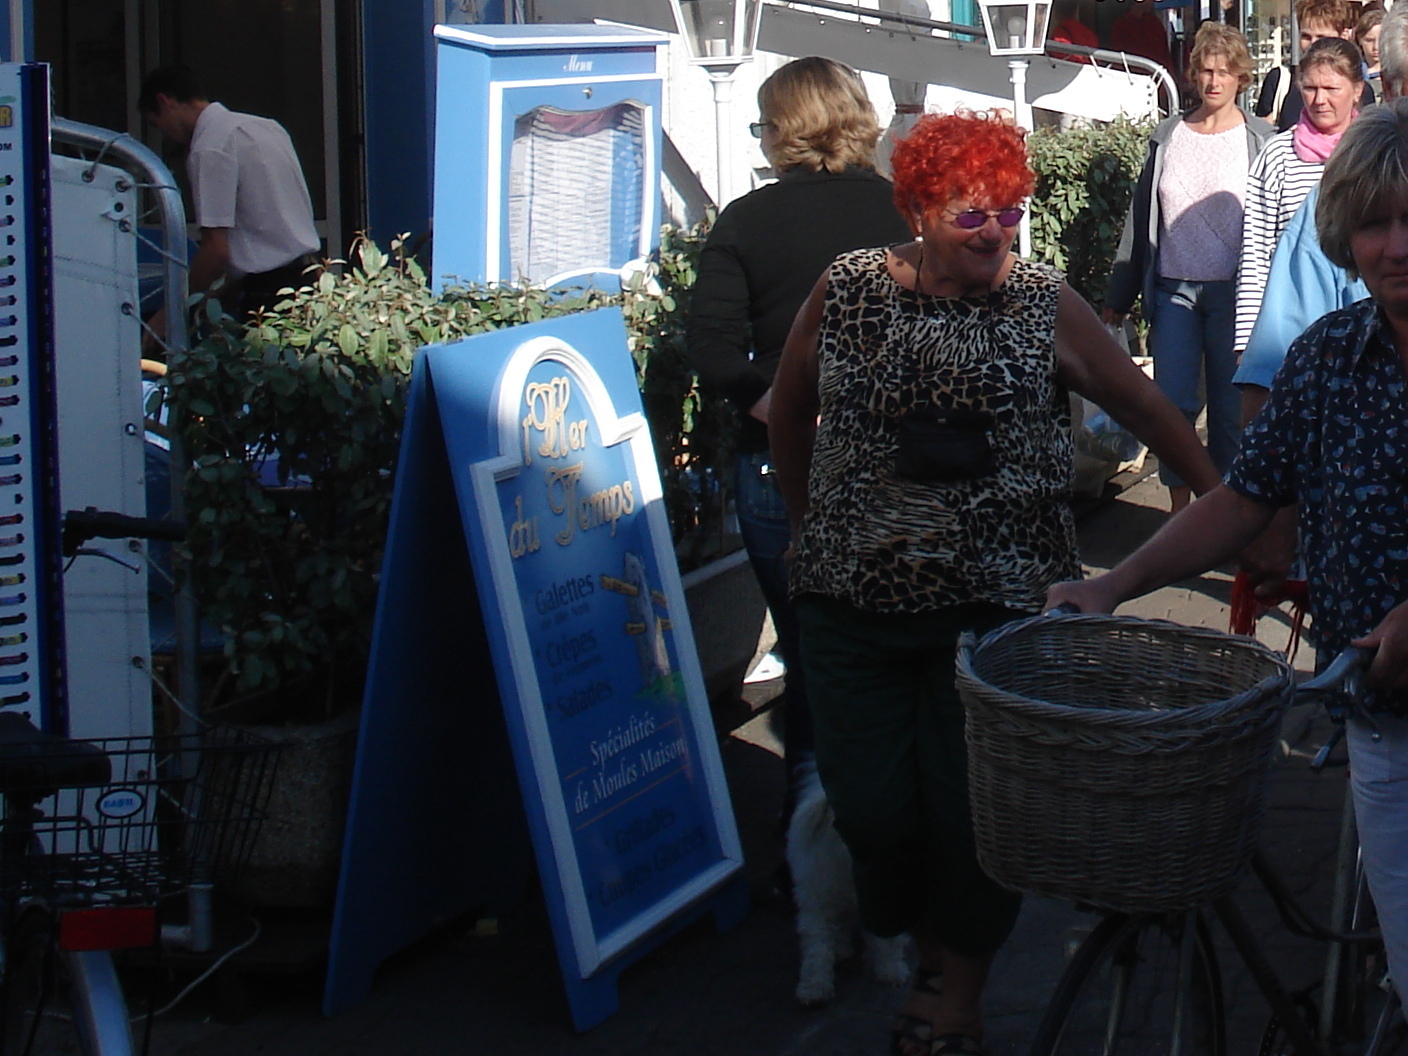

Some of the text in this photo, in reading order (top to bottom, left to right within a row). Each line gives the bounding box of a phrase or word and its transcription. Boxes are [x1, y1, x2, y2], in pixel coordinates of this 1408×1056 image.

[562, 54, 594, 72] Menu
[522, 376, 588, 468] l'Her
[509, 460, 635, 558] du Temps
[535, 574, 595, 615] Galettes
[590, 711, 656, 771] Spécialités
[574, 738, 687, 814] de Moules Maison
